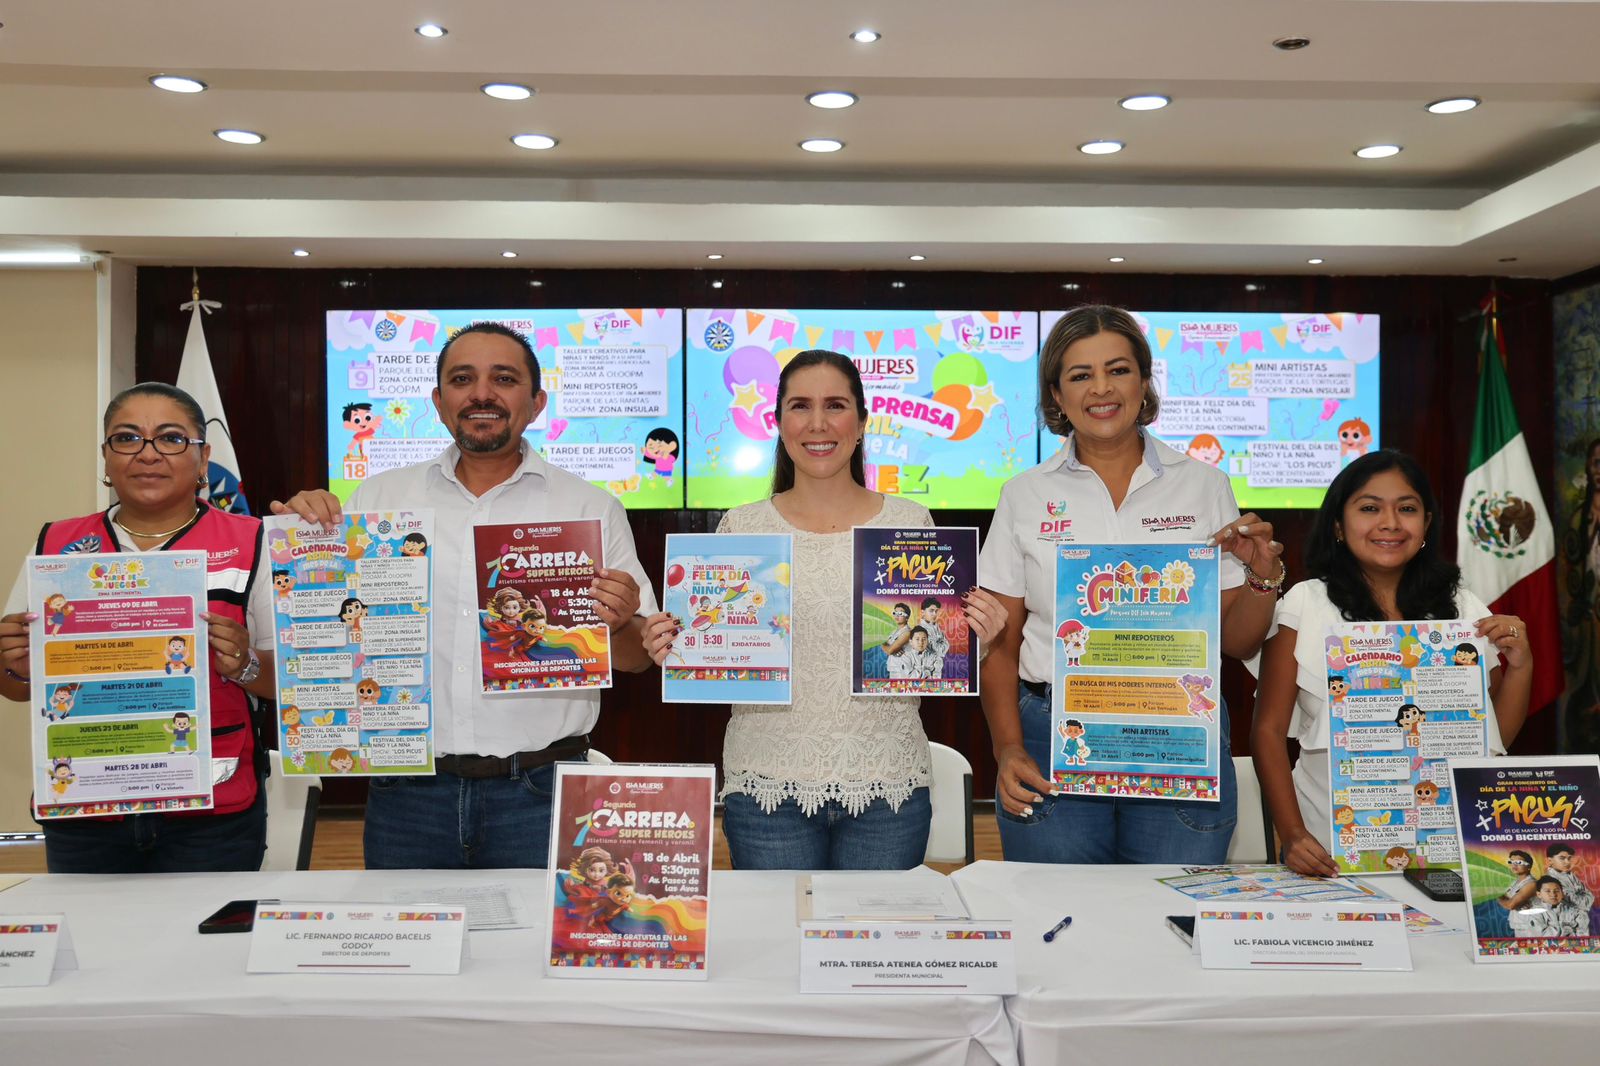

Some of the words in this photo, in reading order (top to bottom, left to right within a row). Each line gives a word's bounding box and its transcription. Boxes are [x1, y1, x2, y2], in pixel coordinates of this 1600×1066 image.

[611, 320, 631, 328] DIF
[990, 327, 1022, 340] DIF
[377, 356, 412, 364] TARDE
[416, 356, 431, 364] DE
[355, 371, 368, 387] 9
[1231, 374, 1250, 386] 25
[345, 464, 366, 478] 18
[1236, 460, 1244, 473] 1
[1161, 516, 1196, 524] MUJERES
[1040, 520, 1072, 533] DIF
[509, 545, 539, 553] Segunda
[501, 551, 590, 571] CARRERA
[527, 569, 556, 578] SUPER
[693, 571, 725, 581] FELIZ
[728, 568, 751, 581] DÍA
[103, 581, 137, 590] JUEGOS
[550, 589, 560, 597] 18
[562, 589, 574, 597] de
[1098, 587, 1190, 604] MINIFERIA
[281, 632, 294, 643] 14
[350, 633, 362, 643] 18
[685, 636, 696, 647] 30
[704, 635, 723, 645] 5:30
[1131, 634, 1175, 642] REPOSTEROS
[288, 663, 300, 673] 21
[494, 661, 540, 669] INSCRIPCIONES
[541, 659, 574, 667] GRATUITAS
[1140, 728, 1170, 736] ARTISTAS
[288, 737, 300, 746] 30
[1335, 736, 1348, 746] 14
[1408, 737, 1420, 747] 18
[1341, 765, 1353, 775] 21
[1480, 785, 1494, 793] DÍA
[603, 801, 636, 809] Segunda
[593, 808, 691, 829] CARRERA
[1406, 814, 1419, 824] 28
[619, 830, 651, 839] SUPER
[1481, 834, 1513, 842] DOMO
[1516, 833, 1592, 841] BICENTENARIO
[1341, 836, 1354, 845] 30
[643, 853, 654, 862] 18
[657, 853, 670, 863] de
[672, 853, 700, 863] Abril
[661, 865, 700, 876] 5:30pm
[662, 876, 687, 885] Paseo
[688, 877, 699, 885] de
[680, 885, 699, 893] Aves
[286, 932, 301, 941] LIC.
[303, 932, 352, 941] FERNANDO
[354, 933, 394, 941] RICARDO
[396, 933, 432, 941] BACELIS
[342, 941, 374, 950] GODOY
[1234, 938, 1250, 947] LIC.
[1252, 939, 1291, 947] FABIOLA
[1292, 939, 1334, 947] VICENCIO
[1336, 938, 1374, 947] JIMÉNEZ
[0, 950, 36, 958] ÁNCHEZ
[925, 959, 958, 968] GÓMEZ
